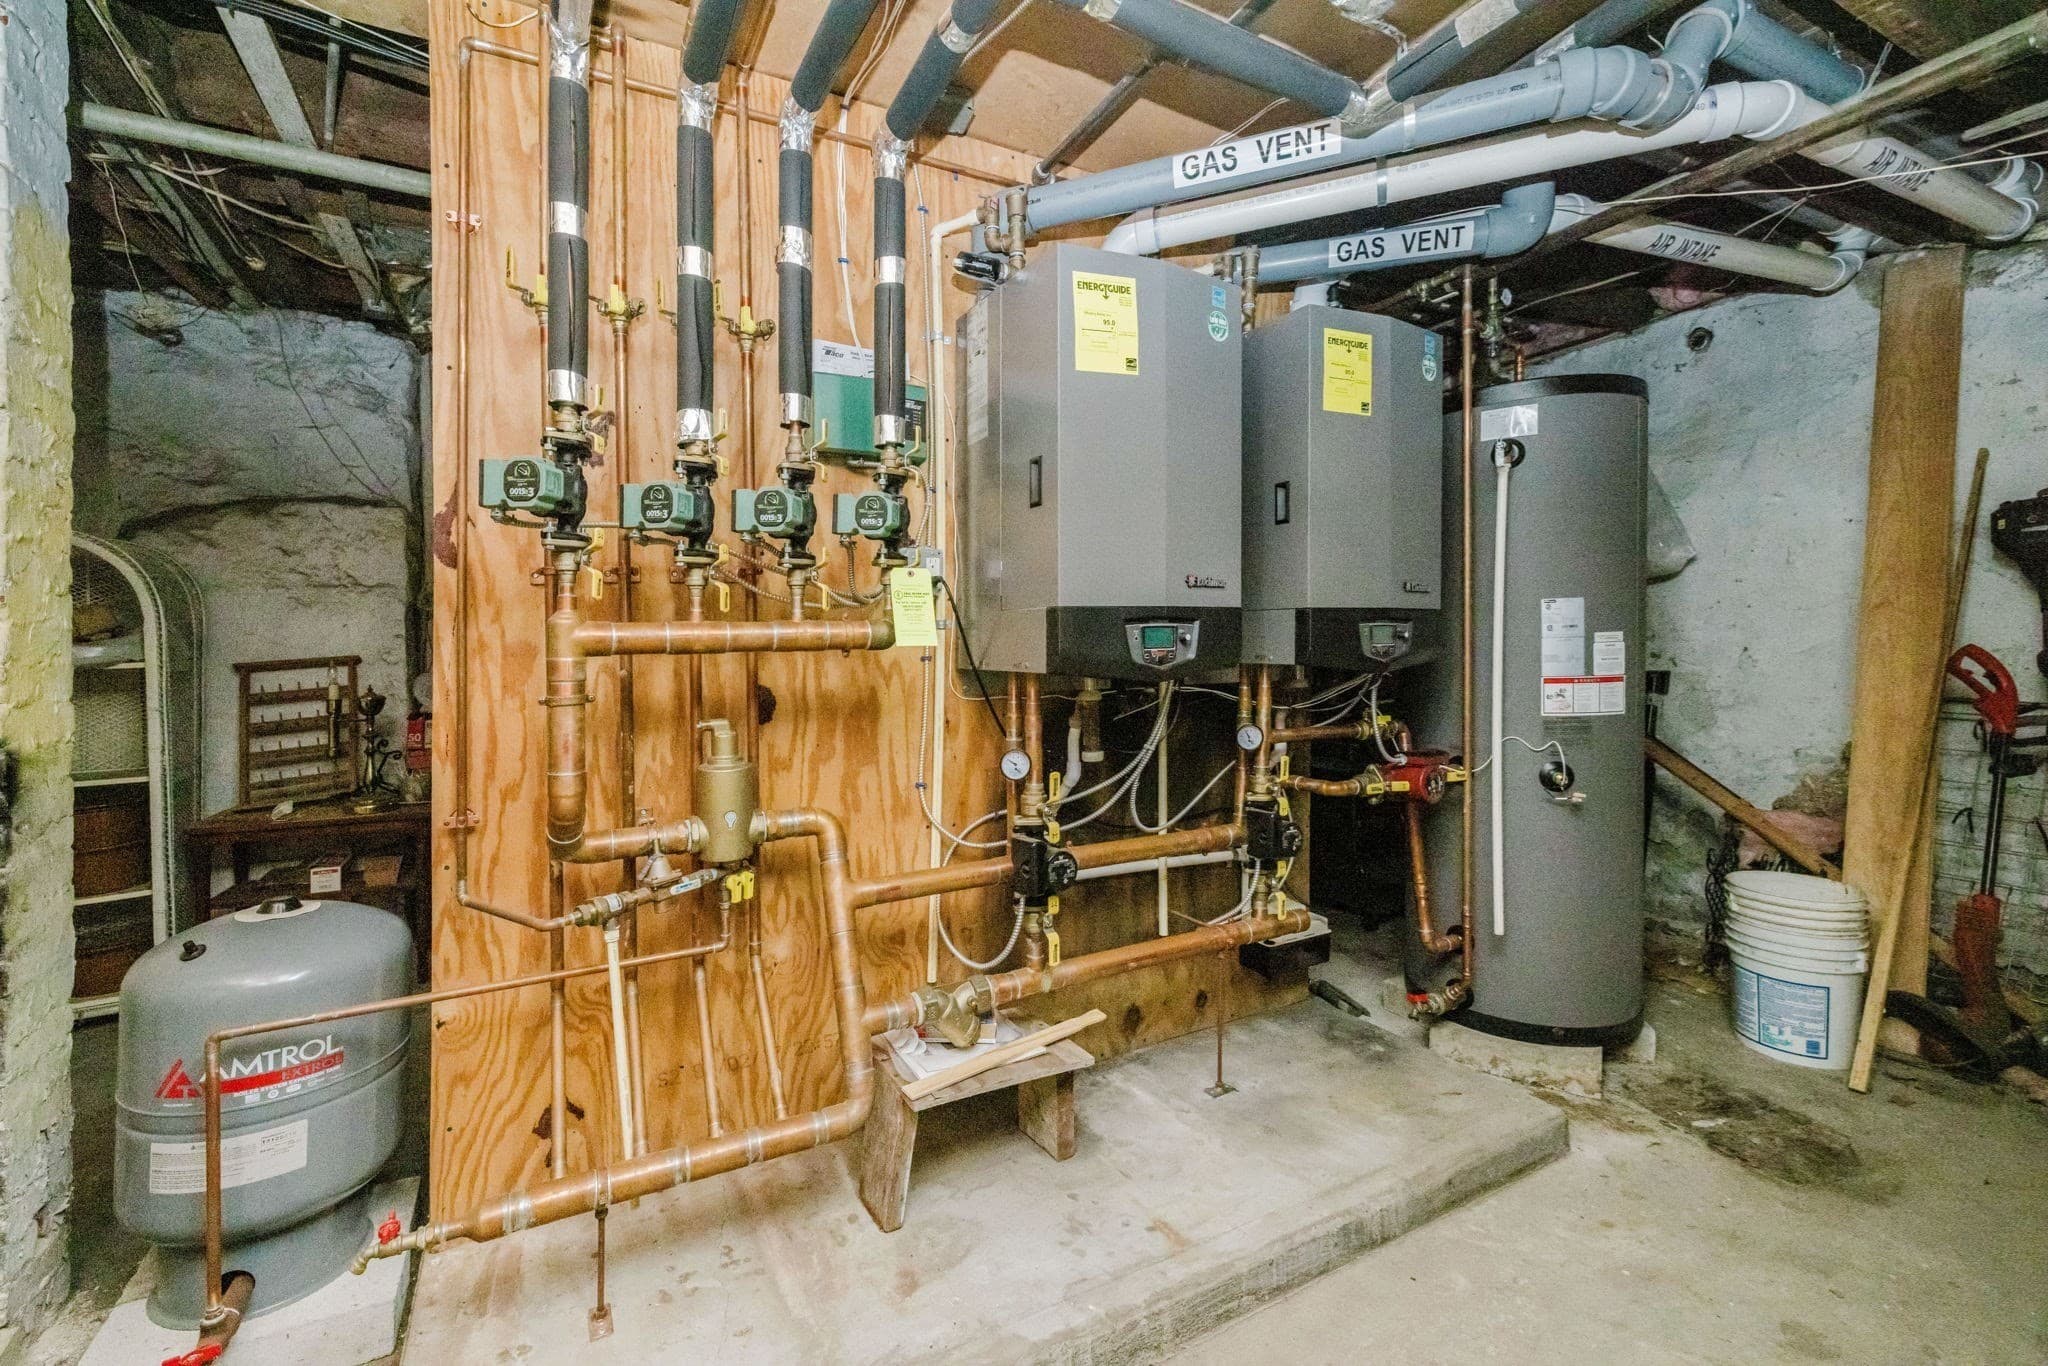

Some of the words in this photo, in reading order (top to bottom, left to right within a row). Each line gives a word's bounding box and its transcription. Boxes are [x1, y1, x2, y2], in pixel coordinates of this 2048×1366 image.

[1182, 145, 1238, 180] GAS
[1256, 123, 1331, 164] VENT
[1862, 146, 1898, 176] AIR
[1885, 156, 1936, 192] INTAKE
[1336, 236, 1385, 262] GAS
[1401, 225, 1466, 254] VENT
[1644, 232, 1677, 255] AIR
[1670, 238, 1722, 263] INTAKE
[1077, 280, 1132, 296] ENERGYGUIDE
[281, 1053, 343, 1081] EXTROL
